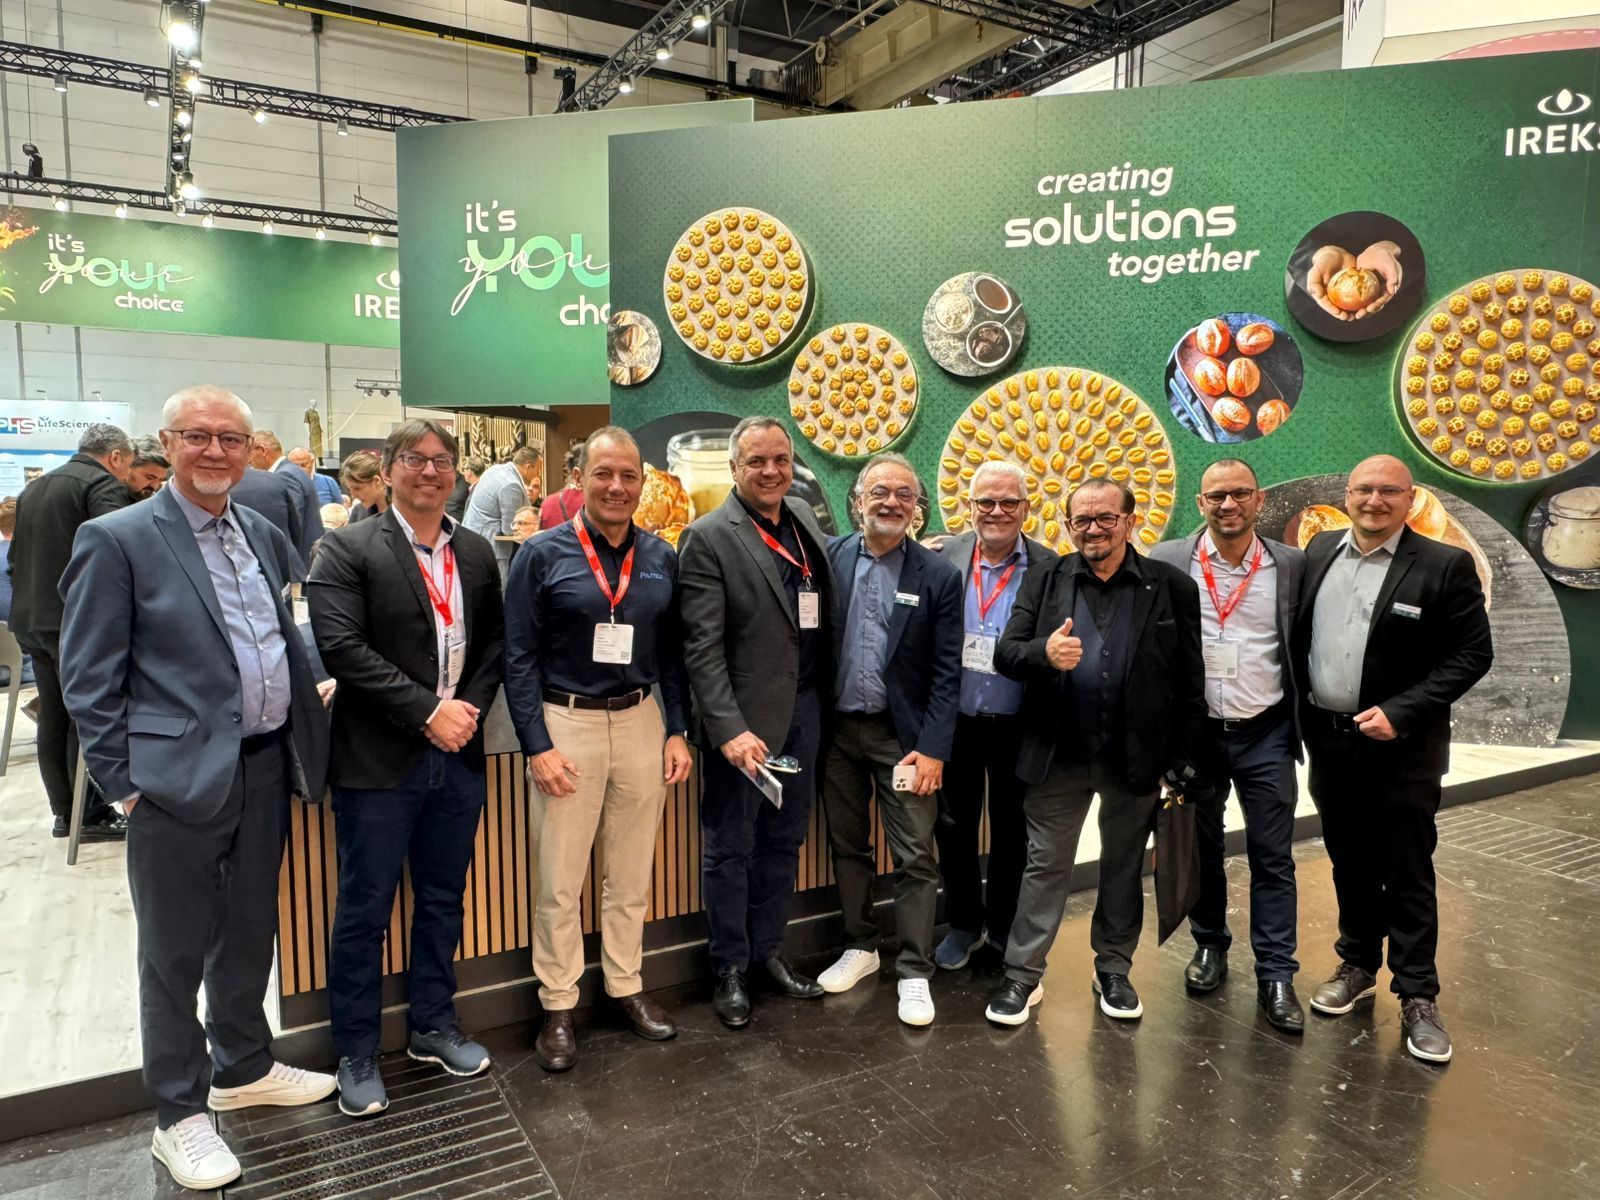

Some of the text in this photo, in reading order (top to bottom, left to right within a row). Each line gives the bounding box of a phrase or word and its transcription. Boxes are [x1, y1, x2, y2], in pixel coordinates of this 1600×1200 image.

[1505, 122, 1600, 156] IREK
[1037, 161, 1174, 196] creating
[466, 200, 517, 233] it's
[1005, 199, 1237, 248] solutions
[48, 233, 85, 253] it's
[1107, 242, 1260, 284] together
[115, 291, 184, 313] choice
